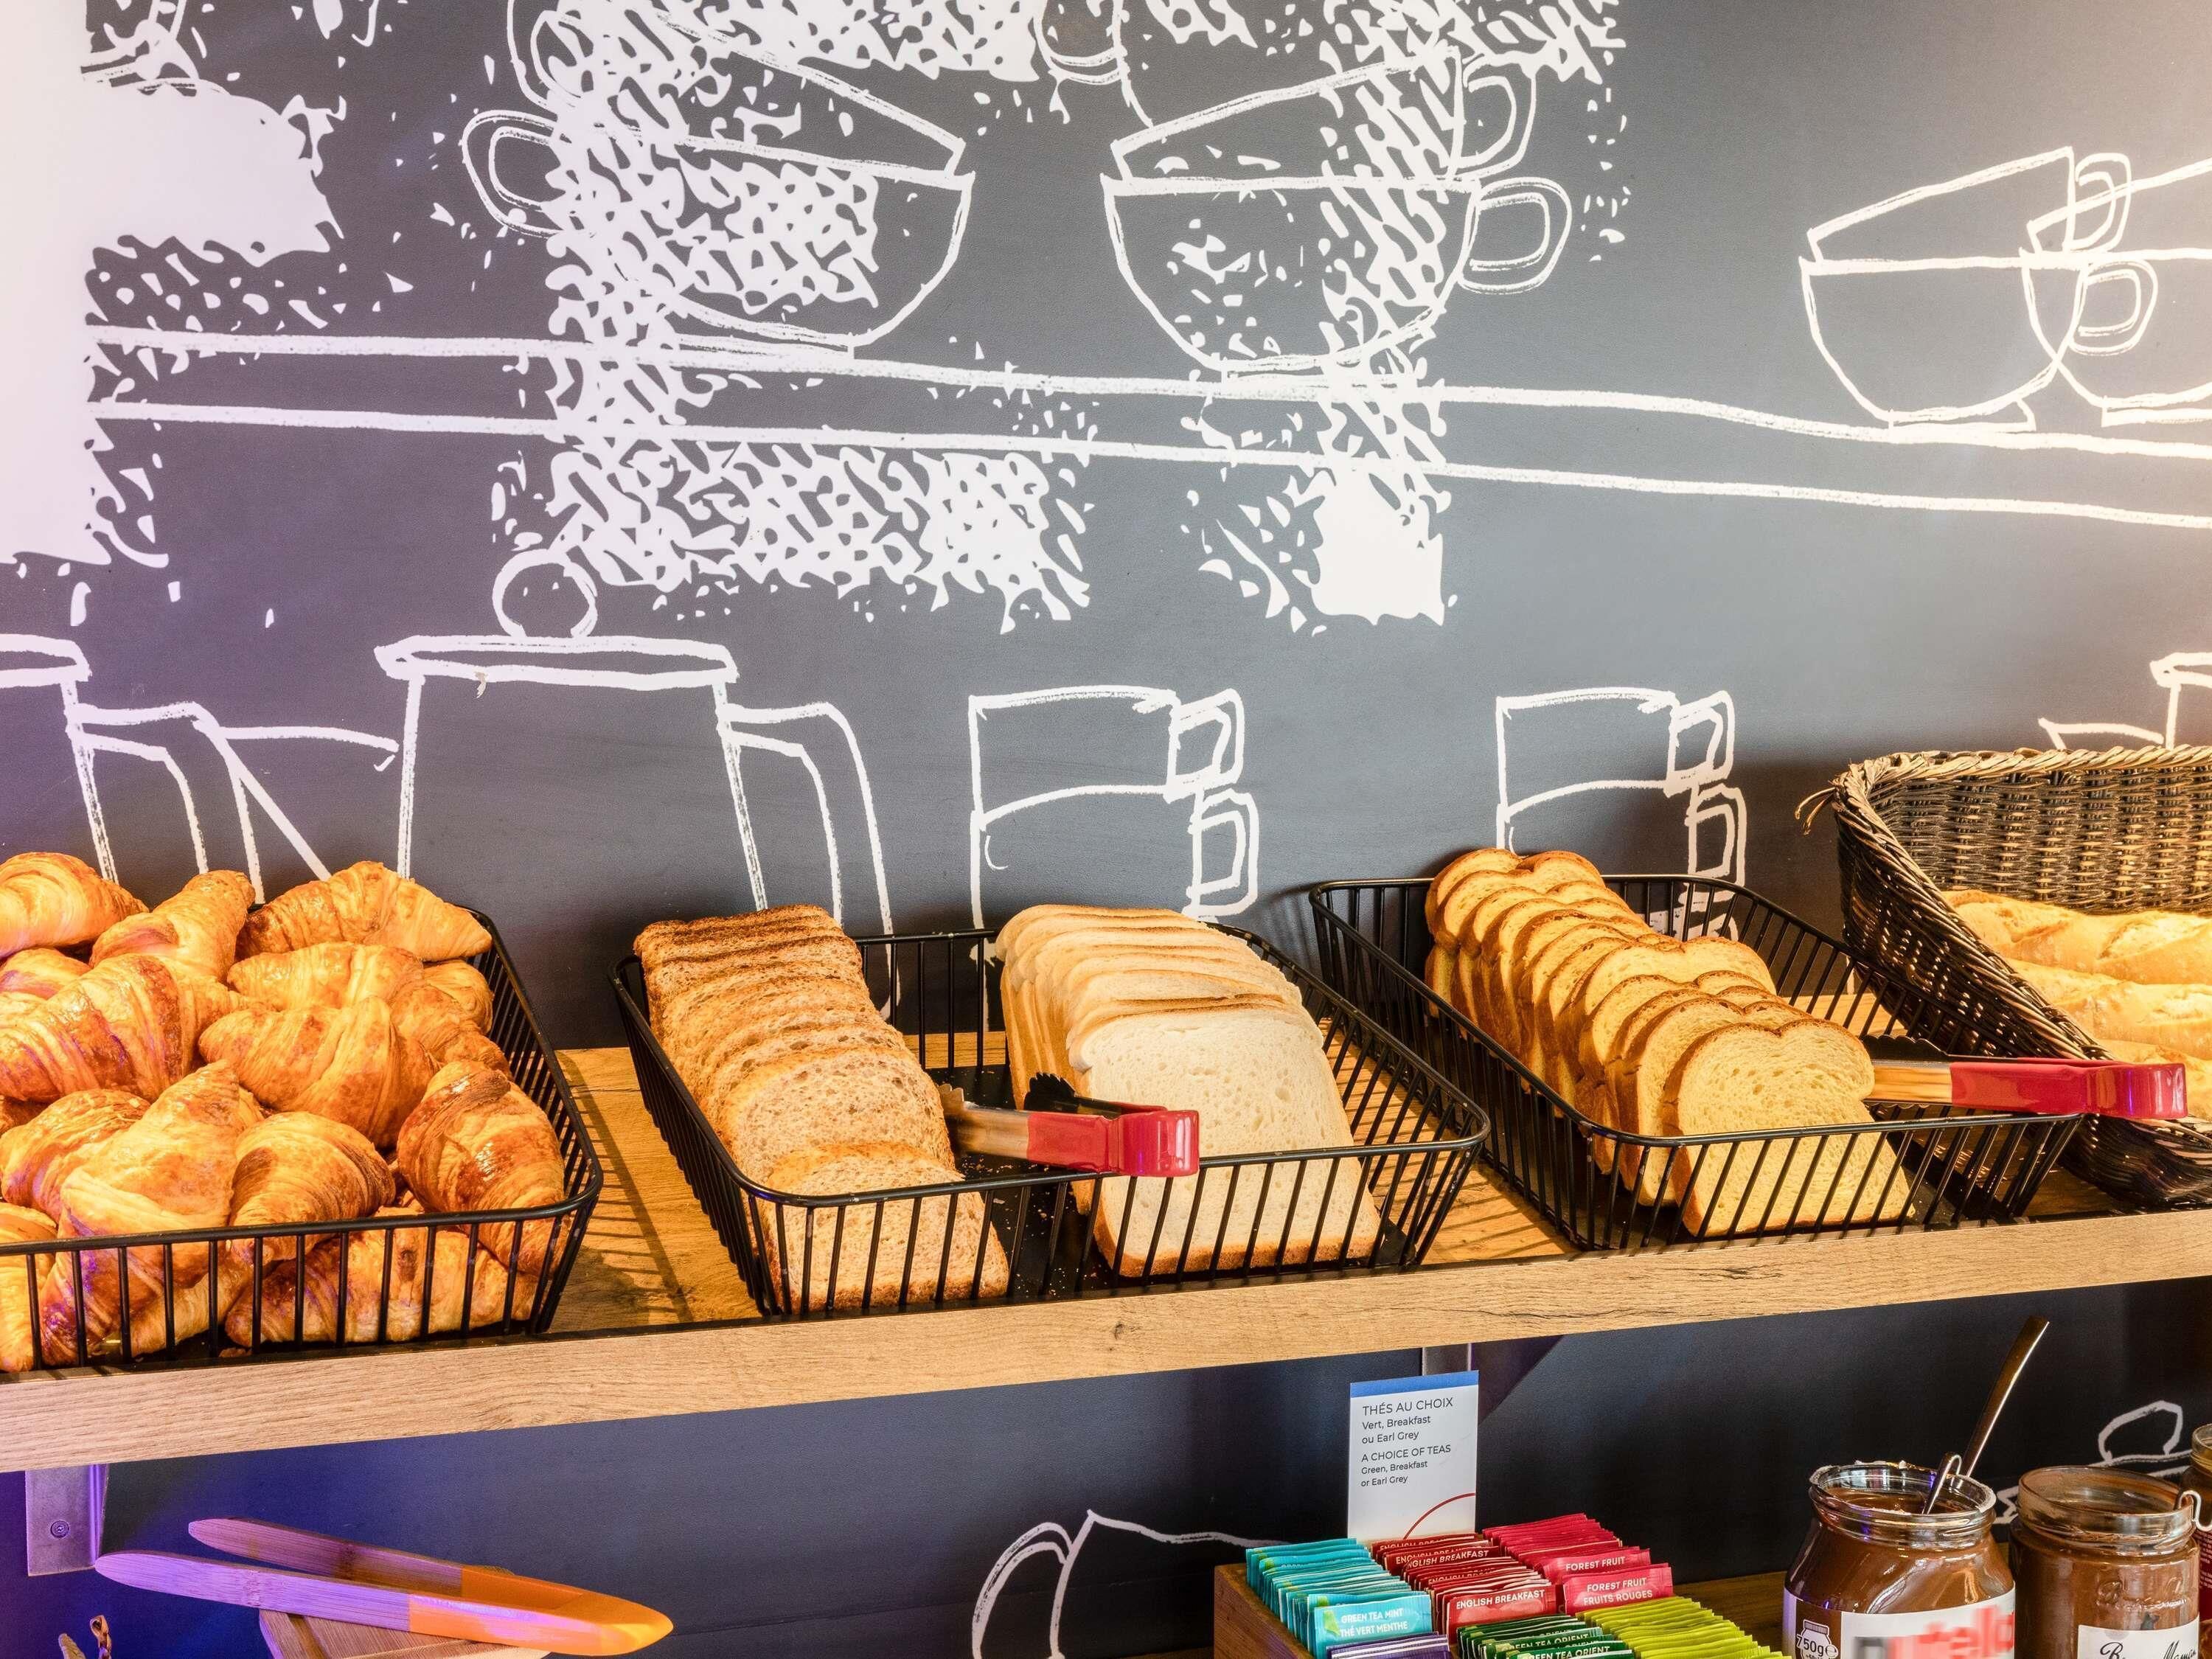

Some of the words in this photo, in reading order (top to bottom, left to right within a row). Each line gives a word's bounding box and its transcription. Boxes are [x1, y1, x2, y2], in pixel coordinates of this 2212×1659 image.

[1363, 1402, 1393, 1416] THÉS
[1396, 1402, 1412, 1412] AU
[1416, 1397, 1453, 1410] CHOIX
[1363, 1421, 1384, 1430] Vert,
[1387, 1416, 1431, 1427] Breakfast
[1377, 1433, 1394, 1442] Earl
[1397, 1431, 1419, 1440] Grey
[1361, 1454, 1368, 1462] A
[1371, 1449, 1408, 1461] CHOICE
[1411, 1447, 1425, 1456] OF
[1427, 1444, 1451, 1455] TEAS
[1361, 1466, 1388, 1475] Green,
[1390, 1461, 1427, 1471] Breakfast
[1372, 1477, 1387, 1486] Earl
[1389, 1475, 1408, 1484] Grey
[1408, 1557, 1437, 1568] NGLISH
[1439, 1550, 1489, 1562] BREAKFAST
[1565, 1560, 1599, 1571] FOREST
[1601, 1556, 1625, 1566] FRUIT
[1587, 1581, 1620, 1593] FOREST
[1622, 1577, 1646, 1587] FRUIT
[1456, 1598, 1492, 1610] ENGLISH
[1495, 1589, 1545, 1605] BREAKFAST
[1583, 1595, 1614, 1606] FRUITS
[1616, 1590, 1652, 1601] ROUGES
[1341, 1613, 1367, 1623] GREEN
[1368, 1611, 1383, 1621] TEA
[1385, 1607, 1404, 1618] MINT
[1340, 1626, 1354, 1637] THÉ
[1356, 1626, 1375, 1635] VERT
[1377, 1621, 1408, 1633] MENTHE
[1555, 1651, 1573, 1659] TEA
[1575, 1646, 1610, 1656] ORIENT
